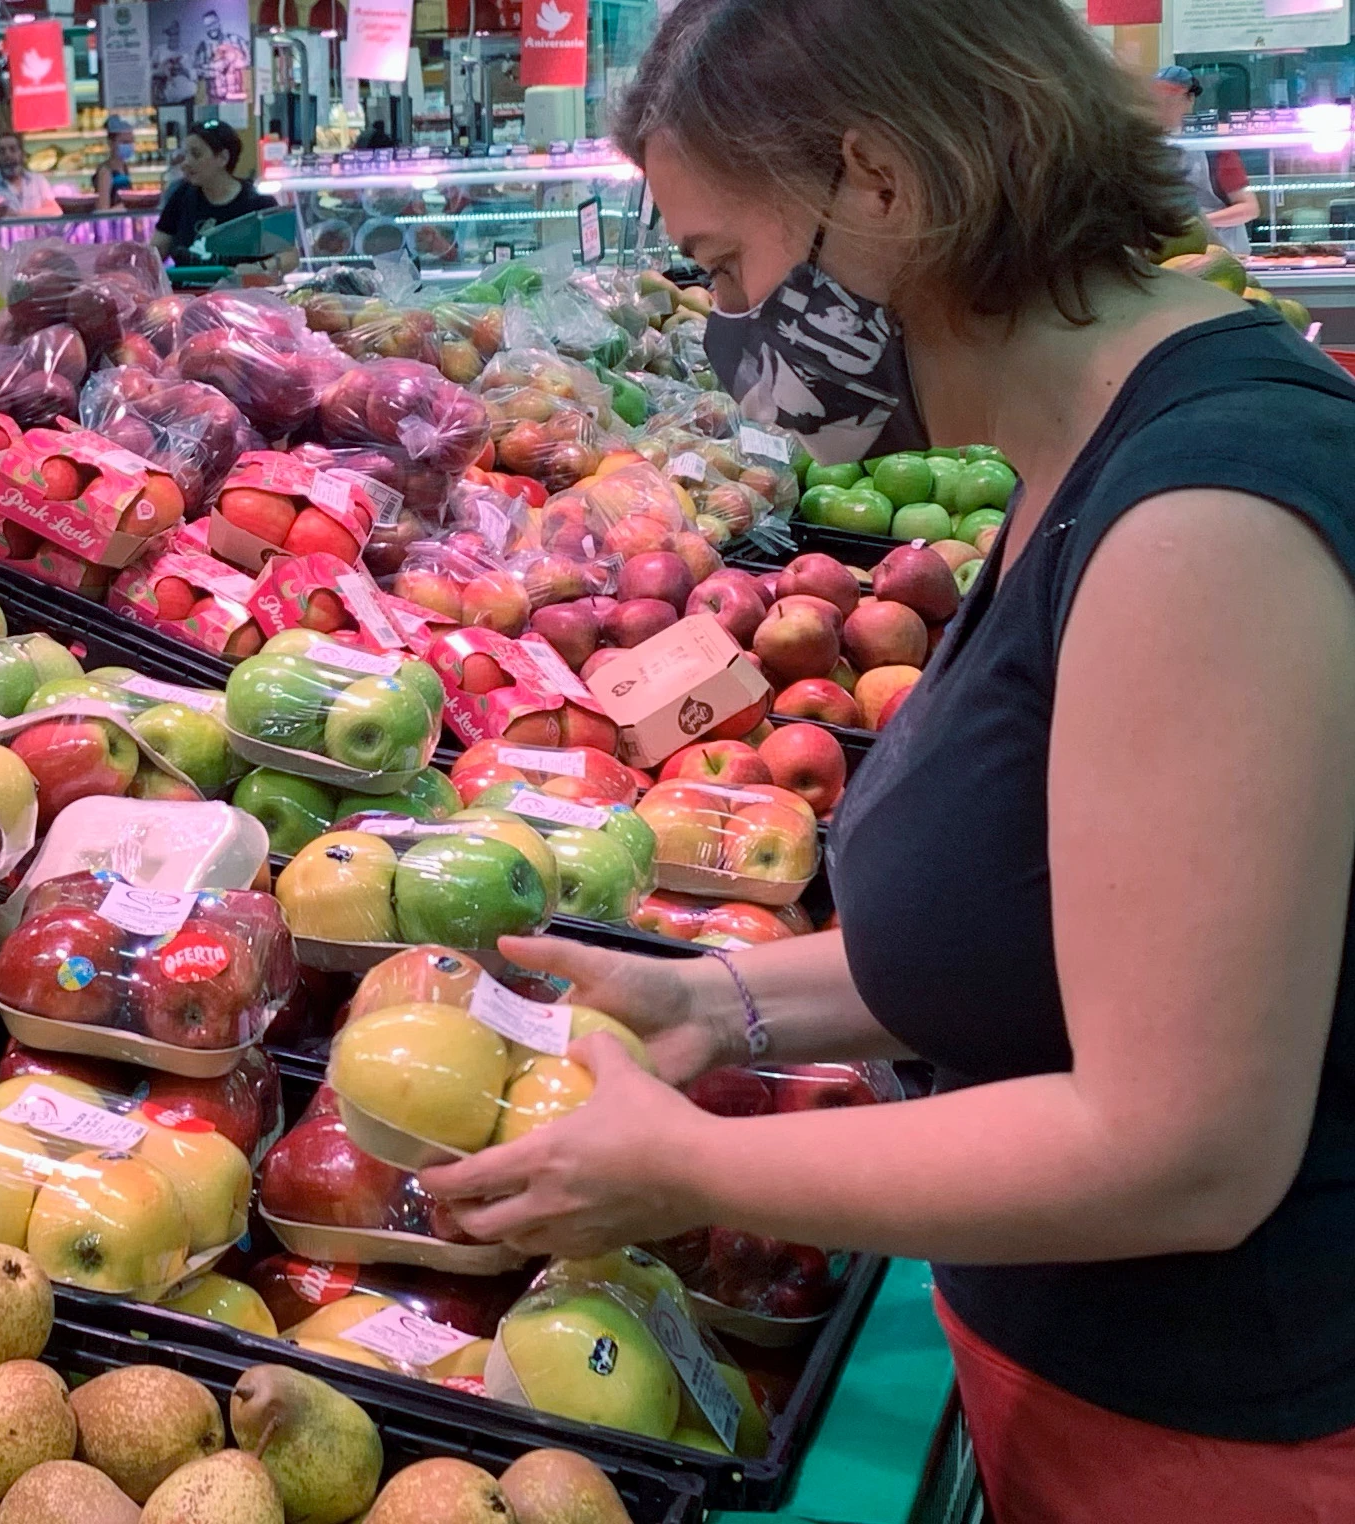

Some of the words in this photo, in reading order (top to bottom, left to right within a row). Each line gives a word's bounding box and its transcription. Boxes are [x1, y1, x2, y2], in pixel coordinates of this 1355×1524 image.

[524, 35, 585, 49] Aniversario
[47, 515, 97, 549] Lady
[257, 594, 286, 634] Pin
[163, 944, 226, 975] OFERTA
